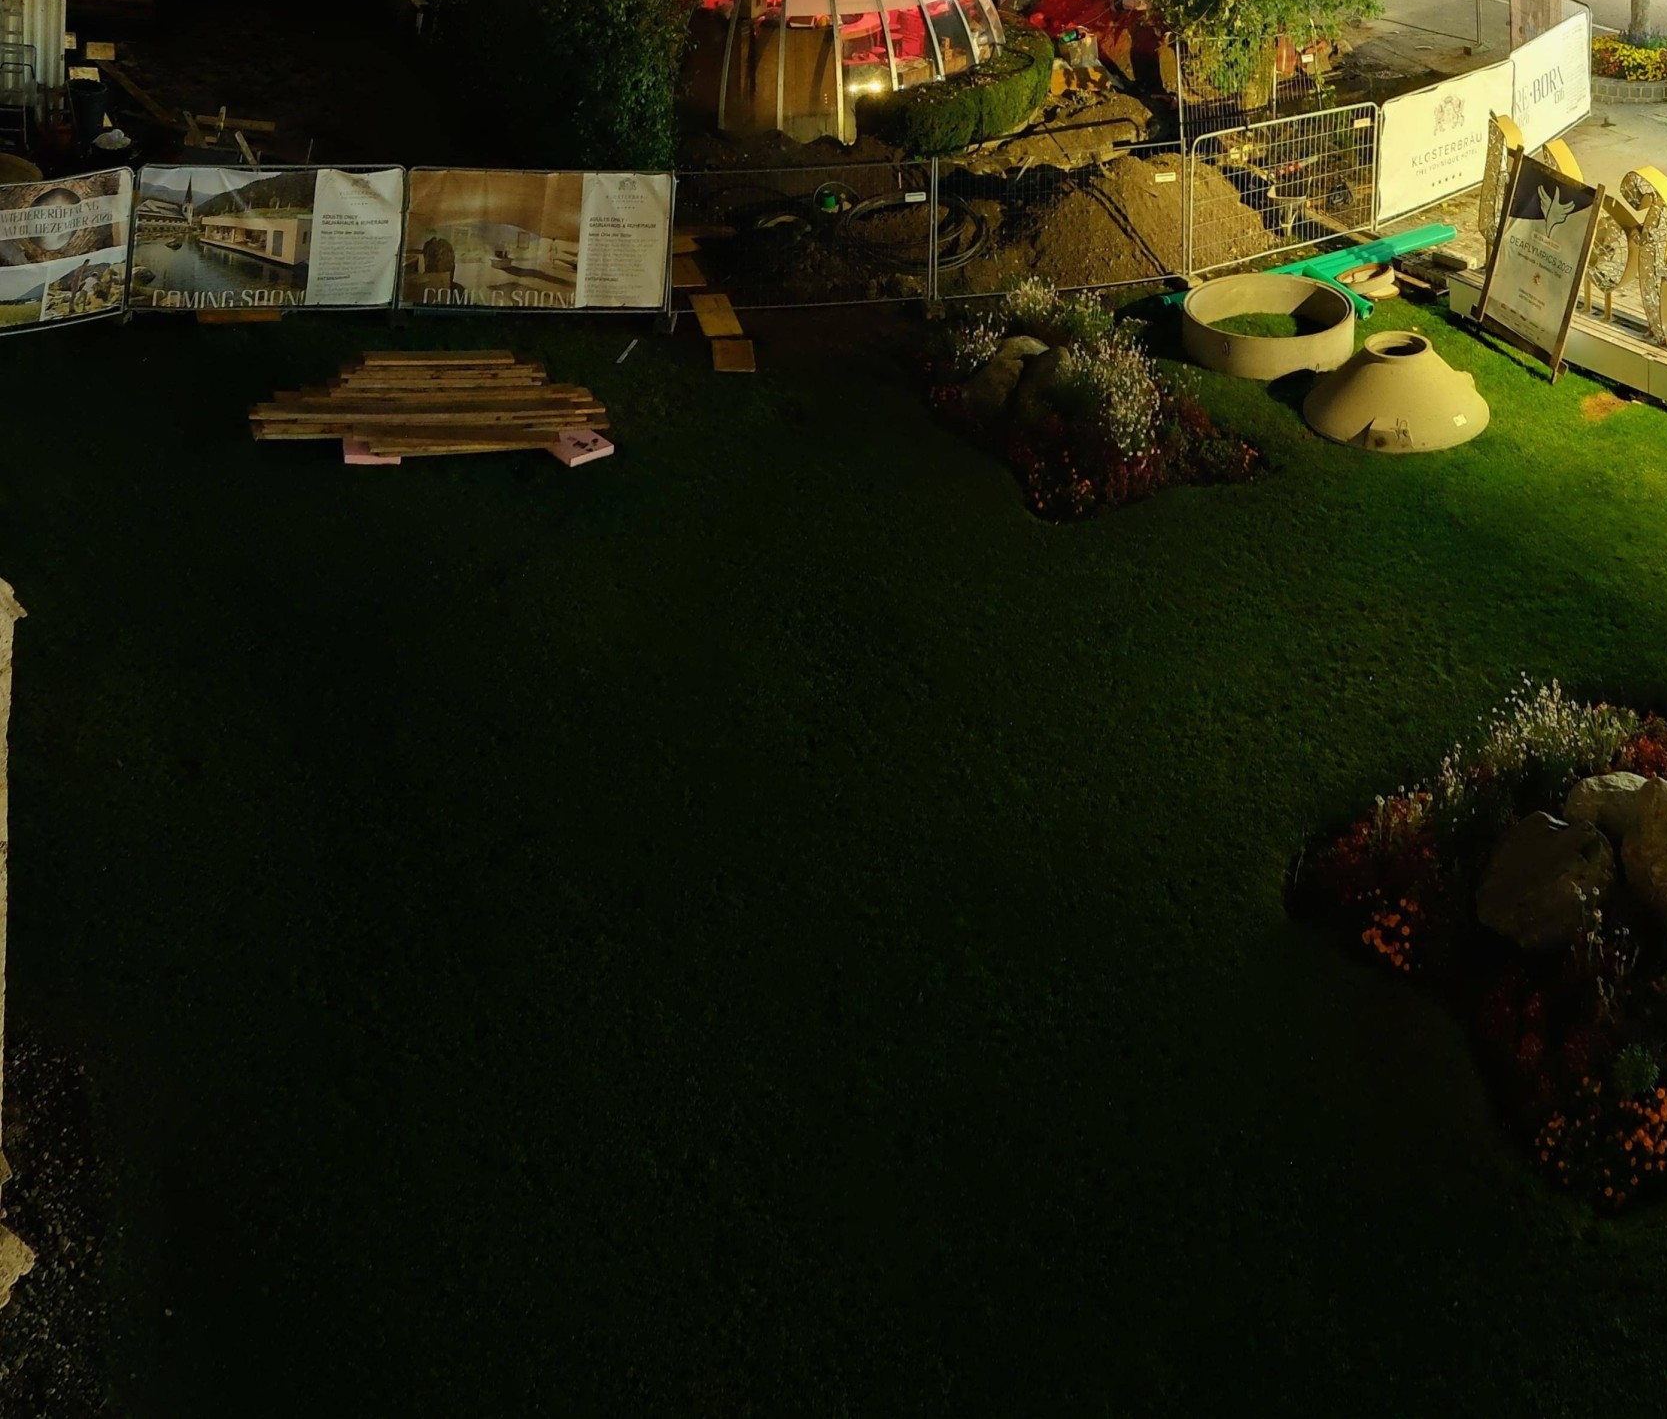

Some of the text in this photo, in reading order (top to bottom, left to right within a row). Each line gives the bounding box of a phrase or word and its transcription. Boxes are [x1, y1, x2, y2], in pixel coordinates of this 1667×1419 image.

[1411, 132, 1482, 168] KLOSTERBRÄU
[34, 215, 90, 235] DEZEMBER
[1509, 235, 1558, 266] DEAFLYMPICS
[1557, 261, 1573, 274] 2027
[152, 289, 234, 308] COMING
[423, 287, 504, 307] COMING
